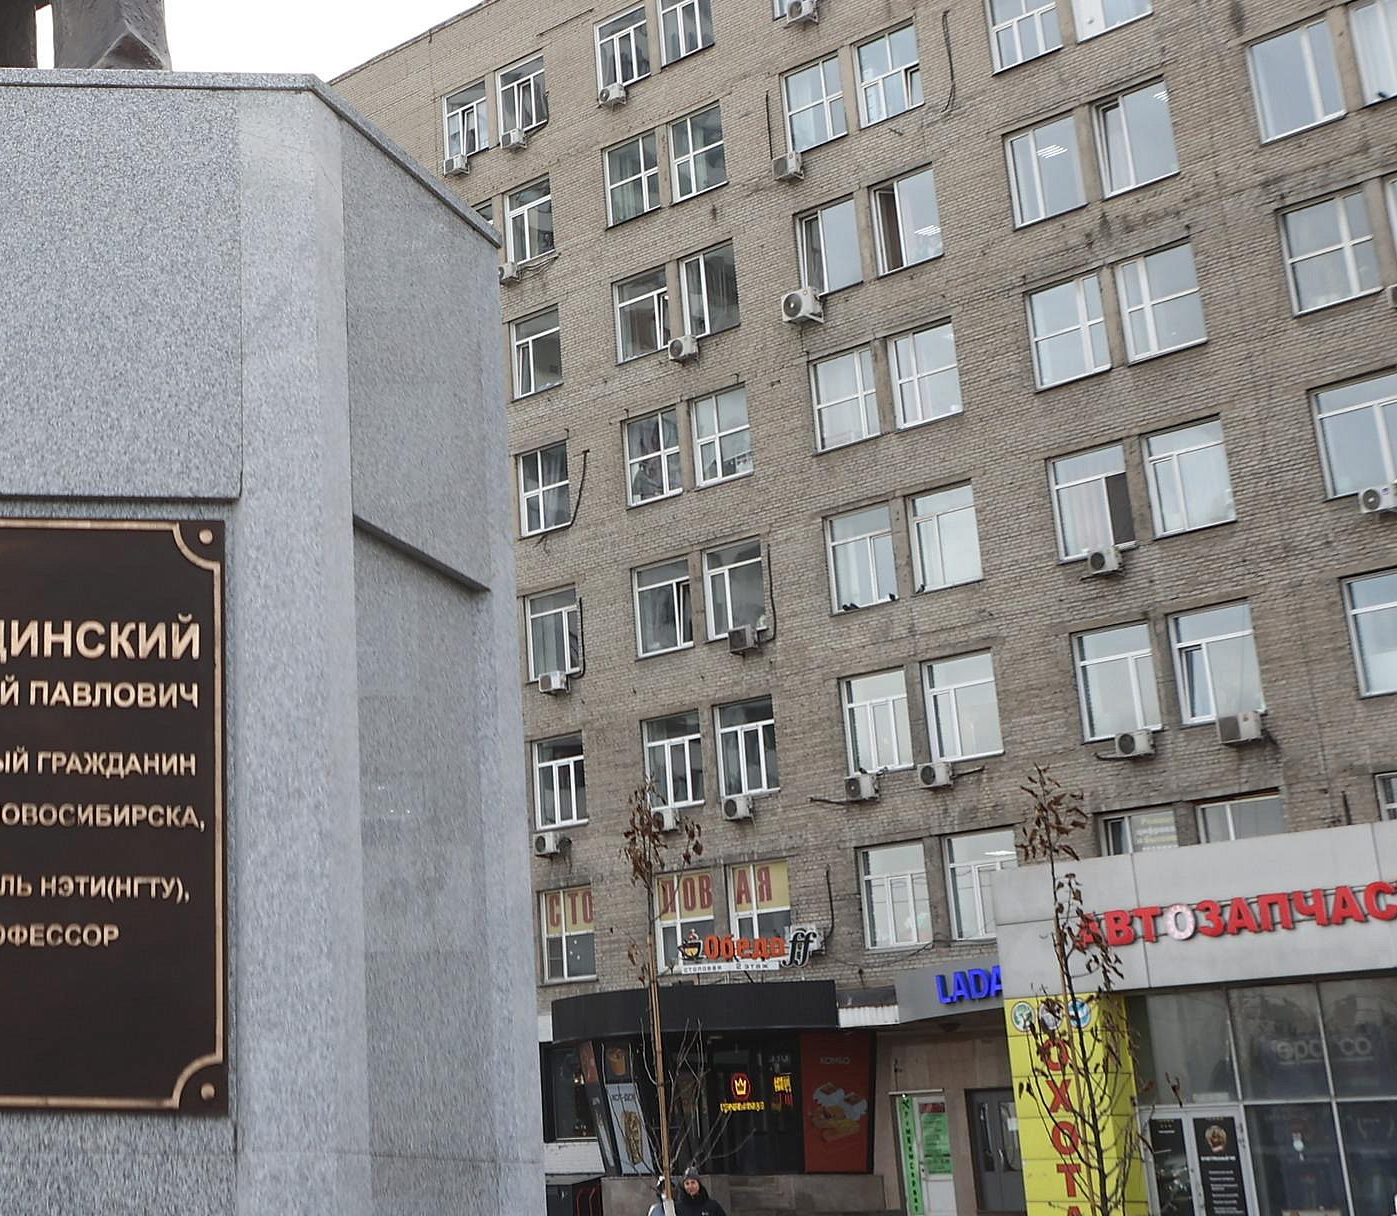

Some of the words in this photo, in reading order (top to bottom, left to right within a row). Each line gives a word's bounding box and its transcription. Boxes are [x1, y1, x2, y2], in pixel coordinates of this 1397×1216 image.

[30, 682, 199, 709] ПАВЛОВИЧ
[37, 753, 197, 778] ГРАЖДАНИН
[40, 876, 190, 904] НЭТИ(НГТУ),
[1077, 880, 1397, 947] АВТОЗАПЧАС
[935, 965, 1003, 1004] LADA
